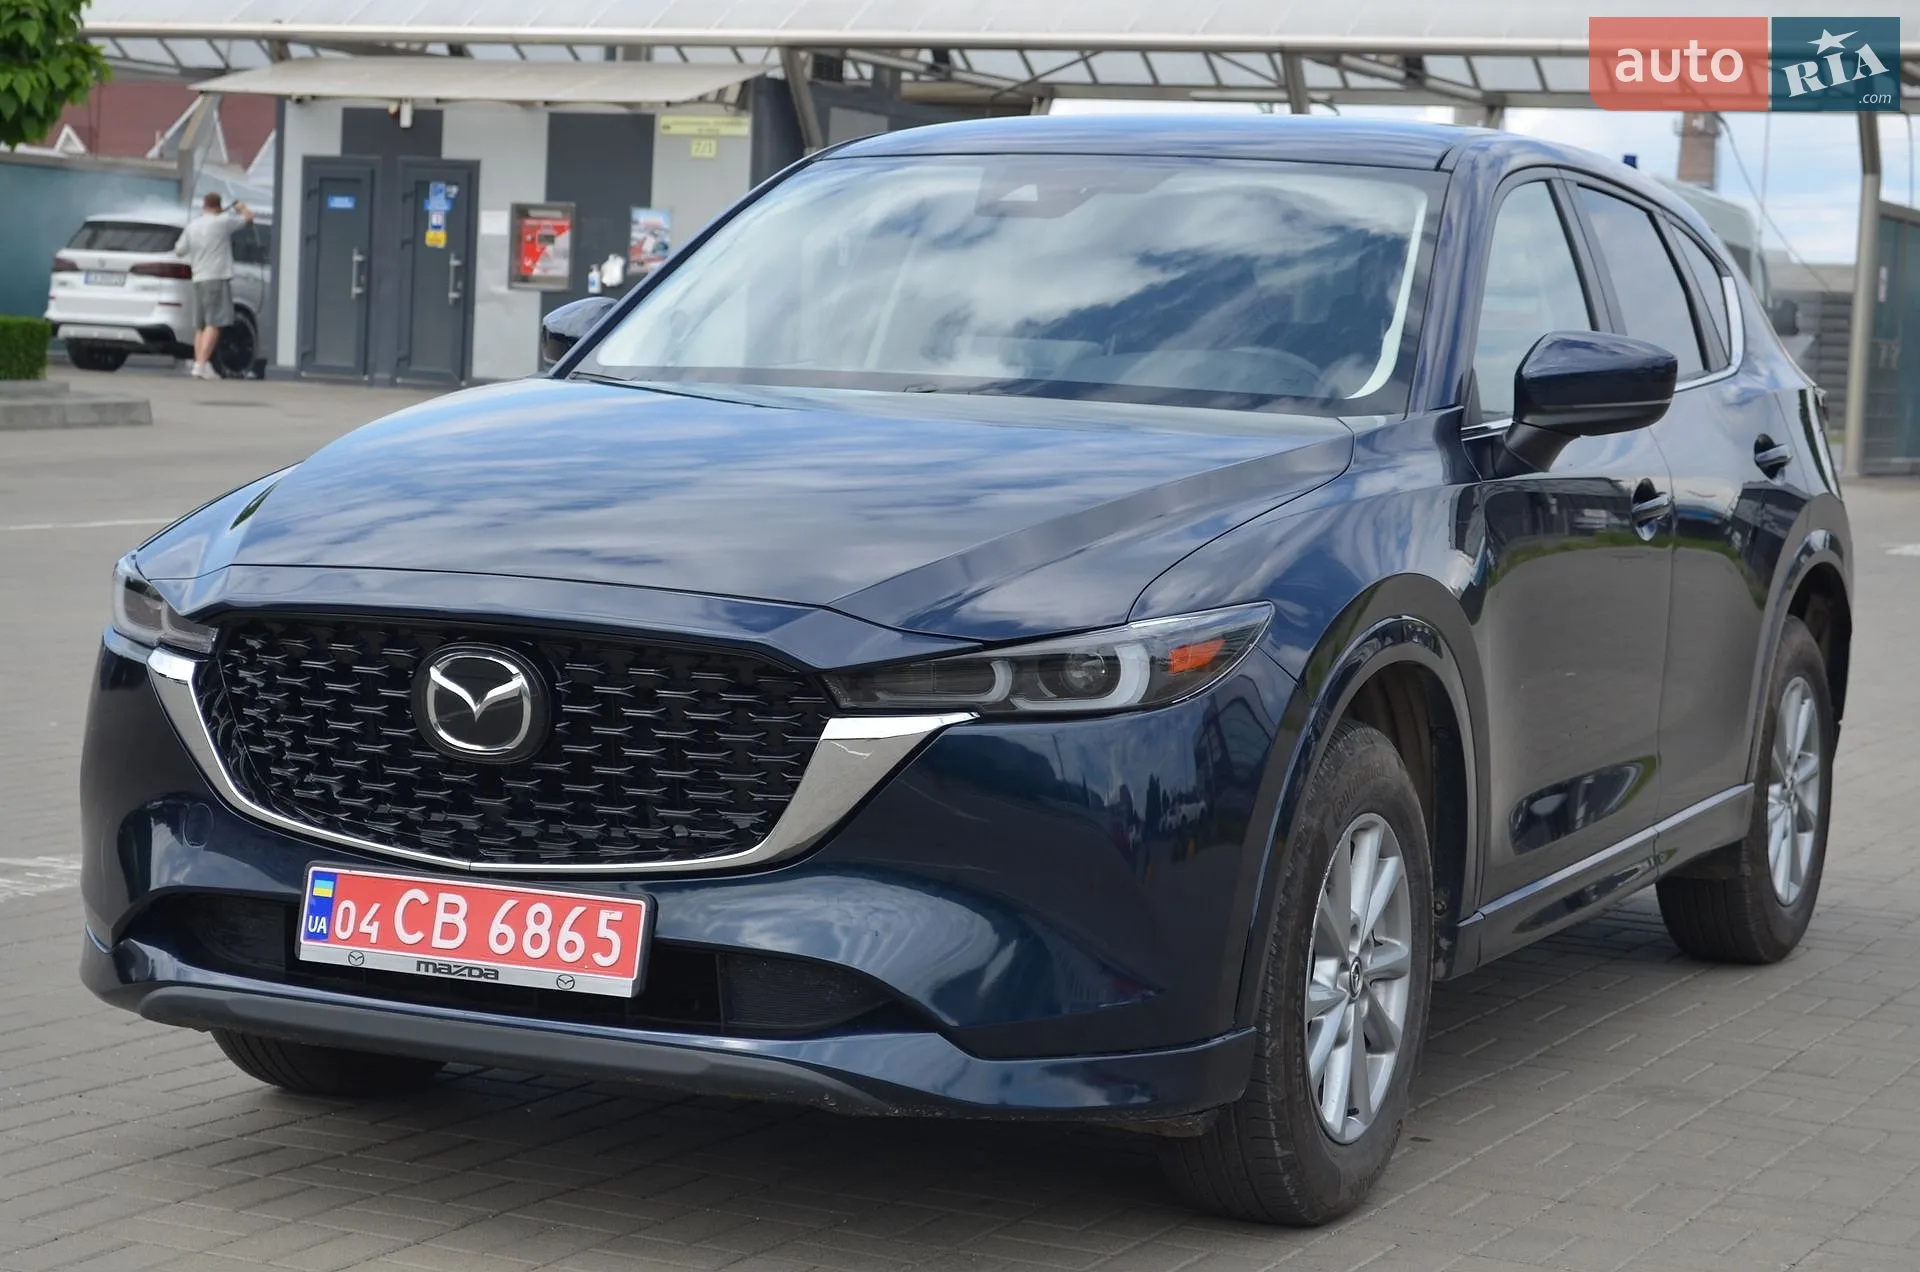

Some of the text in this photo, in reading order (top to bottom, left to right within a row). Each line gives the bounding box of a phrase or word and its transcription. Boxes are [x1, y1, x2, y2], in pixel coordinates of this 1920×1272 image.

[307, 915, 328, 935] UA
[334, 888, 623, 968] 04 CB 6865
[416, 959, 499, 981] mazda
